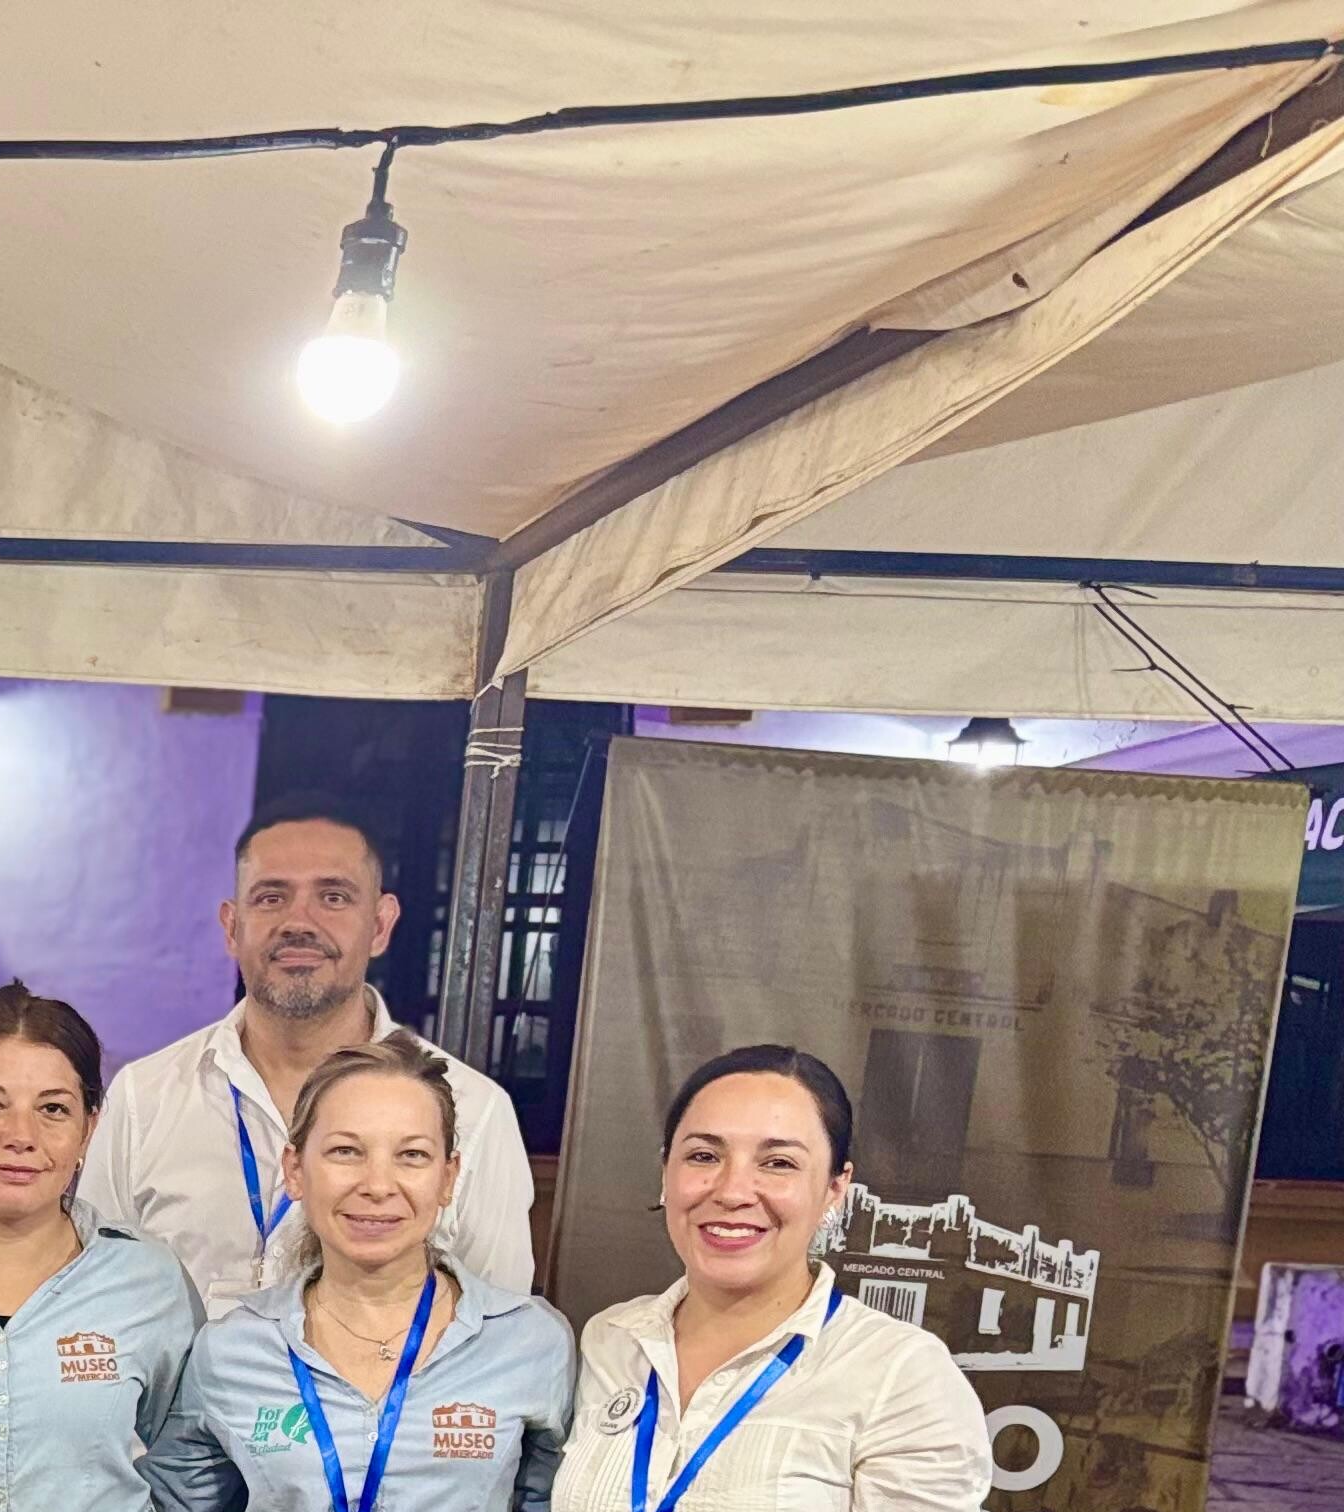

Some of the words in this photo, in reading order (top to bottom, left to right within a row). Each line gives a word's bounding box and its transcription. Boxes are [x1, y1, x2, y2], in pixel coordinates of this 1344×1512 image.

[842, 1264, 895, 1275] MERCADO
[897, 1267, 945, 1280] CENTRAL
[60, 1358, 118, 1374] MUSEO
[433, 1432, 495, 1449] MUSEO
